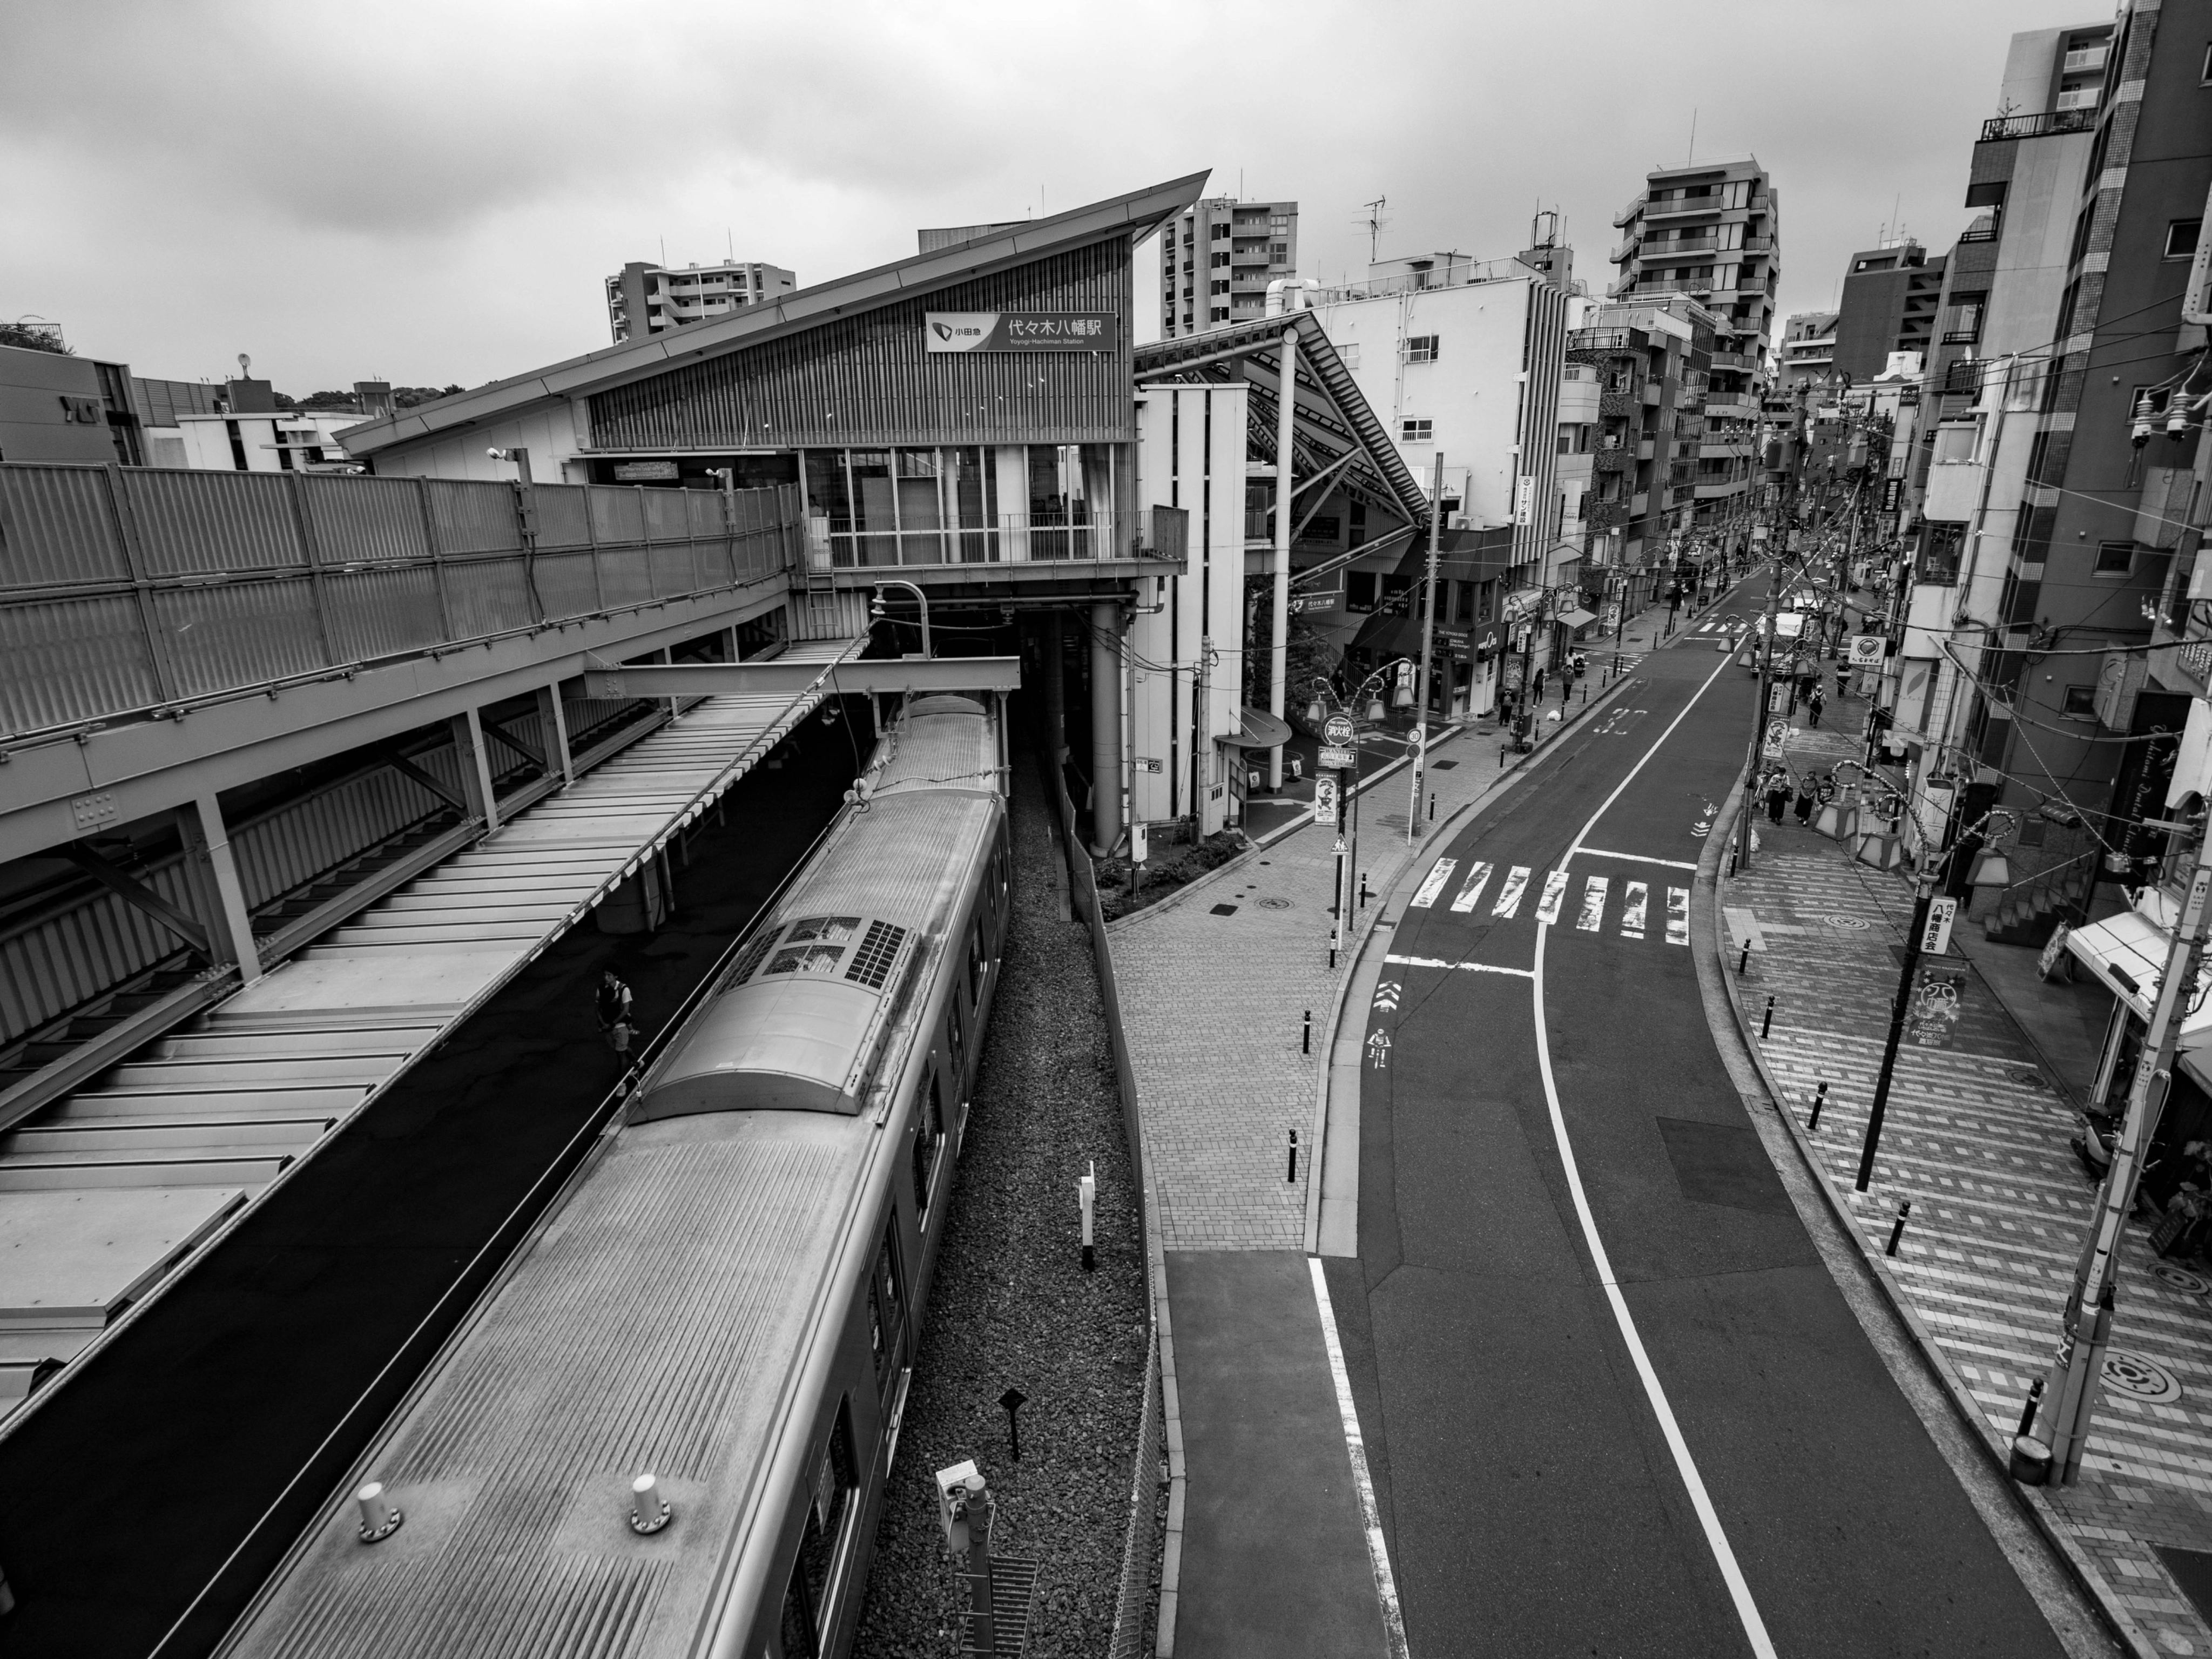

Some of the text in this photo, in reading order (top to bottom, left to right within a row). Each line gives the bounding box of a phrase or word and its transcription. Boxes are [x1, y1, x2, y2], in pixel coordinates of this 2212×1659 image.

[955, 328, 981, 336] 小田急
[1008, 319, 1102, 336] 代々木八幡駅
[1885, 481, 1898, 510] DOUTOR
[1327, 725, 1351, 737] 消火栓
[1410, 732, 1419, 740] 30
[2131, 783, 2152, 819] Dental
[2122, 822, 2141, 853] Clinic
[1943, 903, 1954, 923] 代々木
[1924, 904, 1944, 951] 八幡商店会
[1926, 985, 1952, 1010] 八幡
